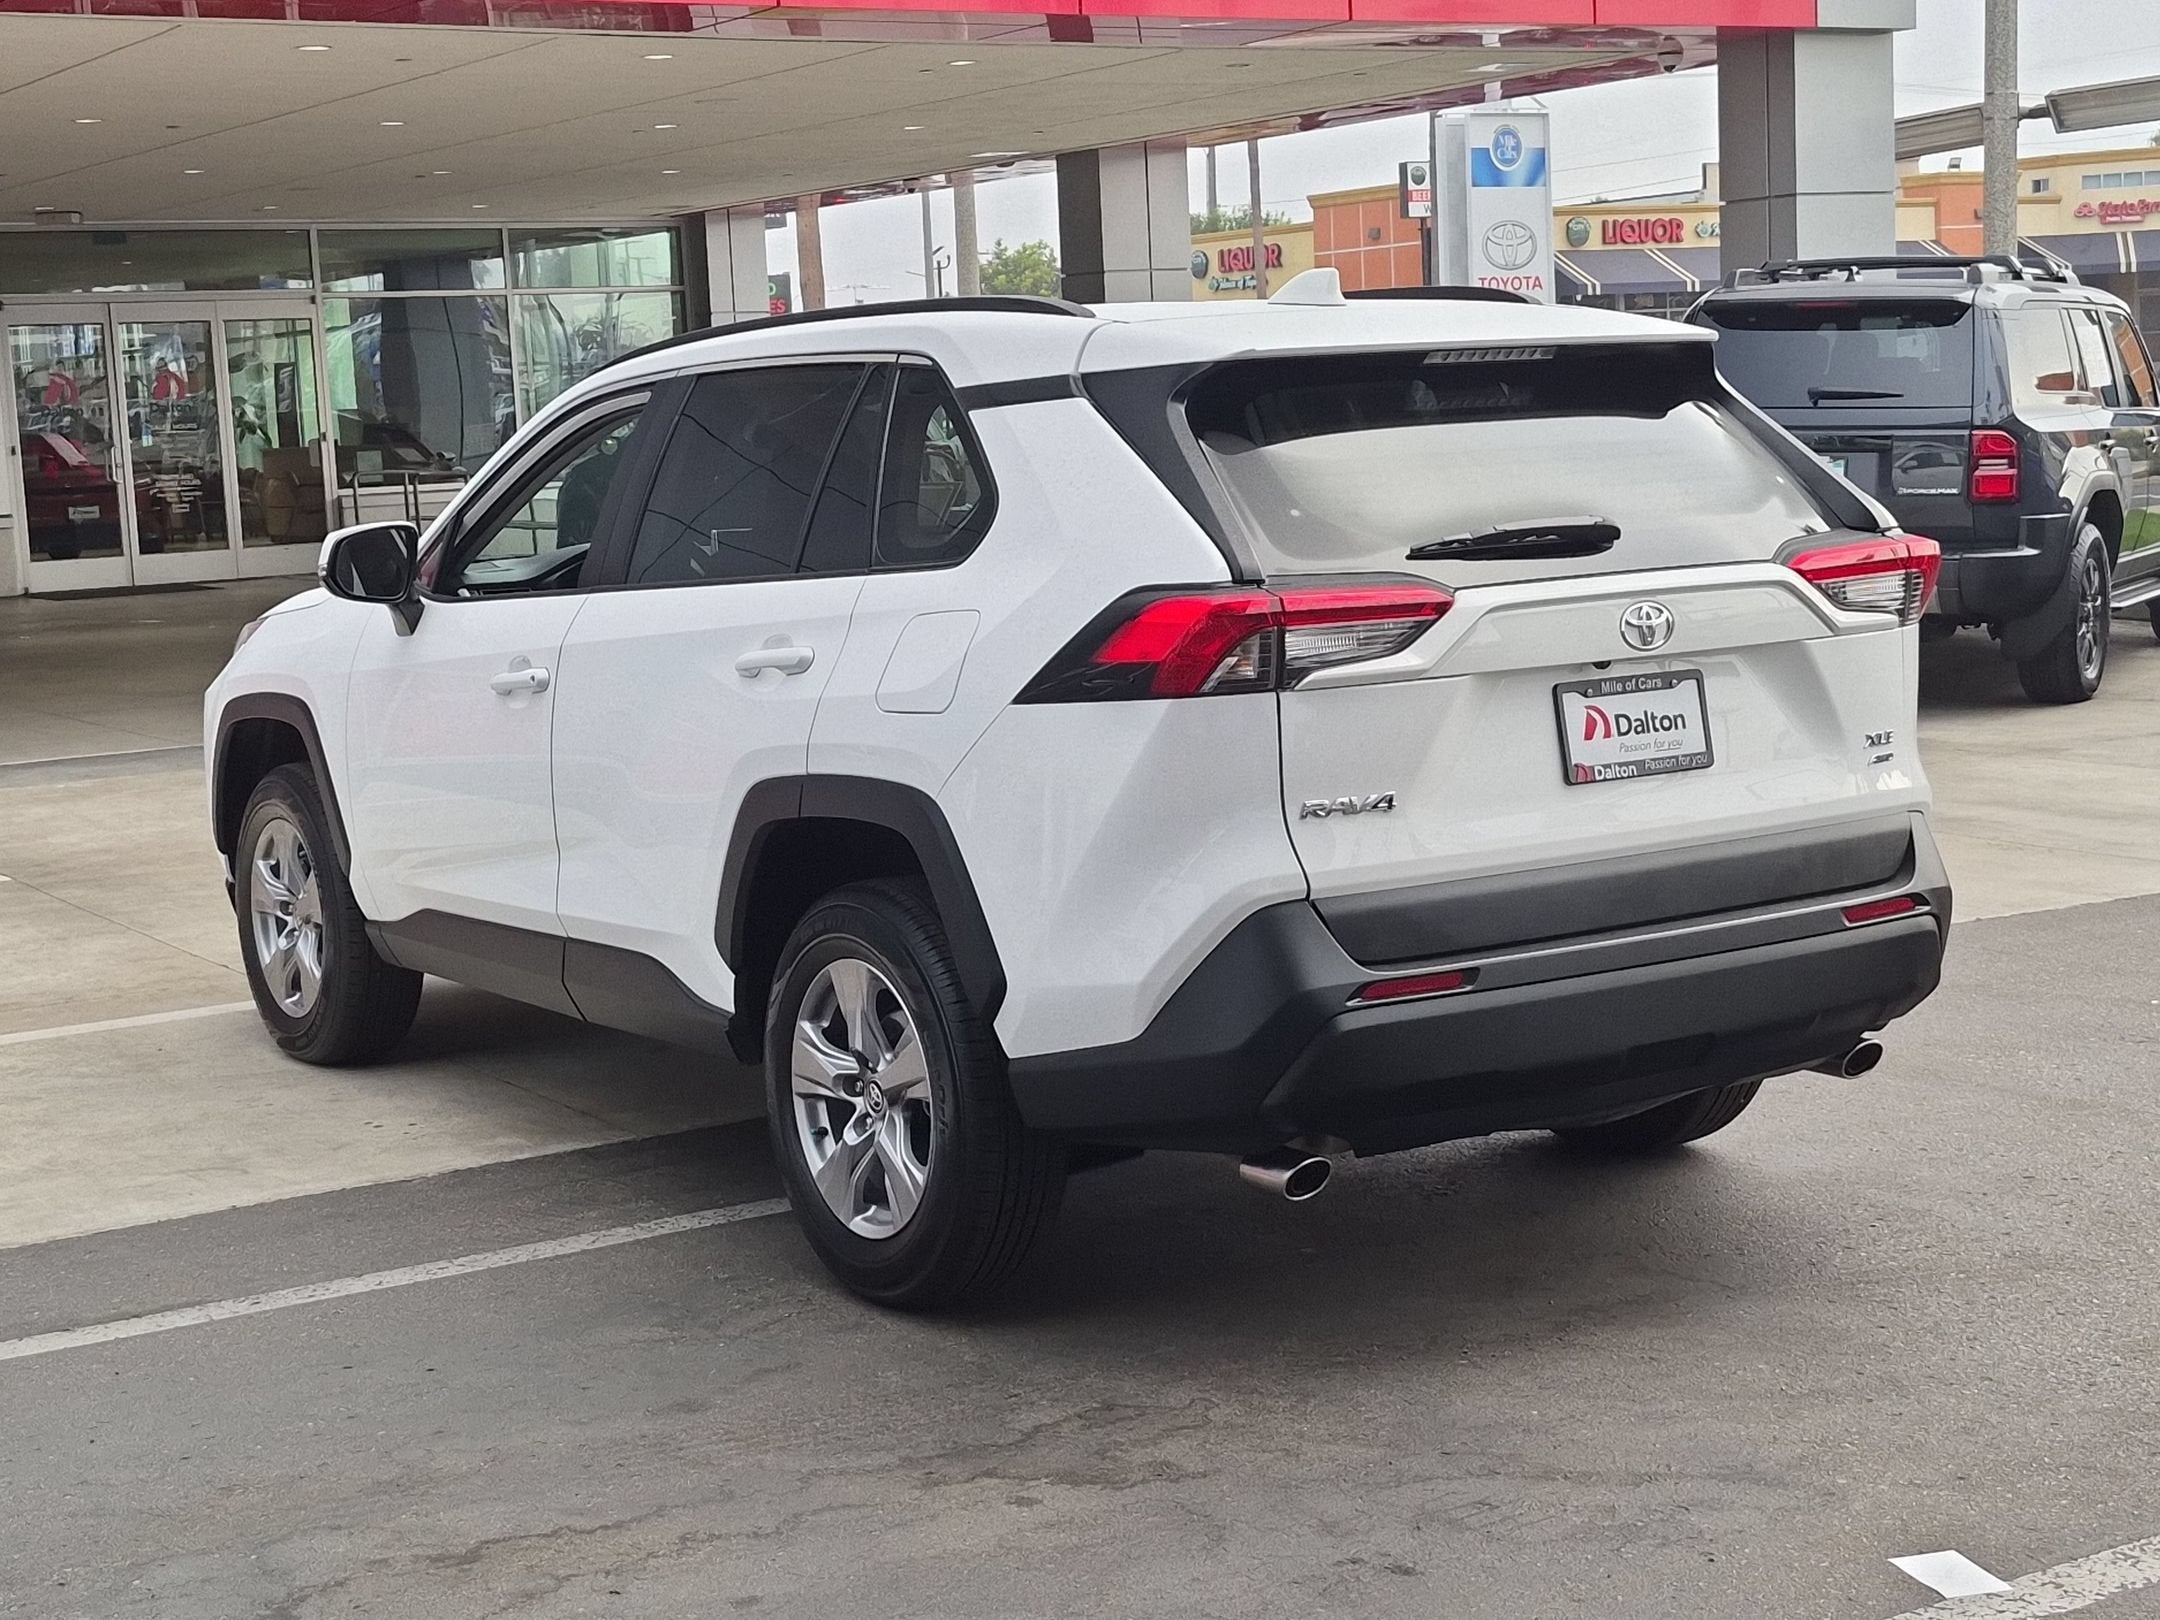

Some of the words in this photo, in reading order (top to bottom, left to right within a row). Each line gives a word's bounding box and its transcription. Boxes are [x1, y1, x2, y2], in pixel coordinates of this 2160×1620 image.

[1602, 218, 1684, 244] LIQUOR
[1478, 276, 1543, 291] TOYOTA
[1601, 680, 1623, 694] Mile
[1625, 680, 1636, 690] of
[1638, 678, 1662, 690] Cars
[1614, 710, 1687, 737] Dalton
[1619, 742, 1651, 753] Passion
[1653, 738, 1666, 750] for
[1667, 739, 1684, 750] you
[1863, 730, 1894, 749] XLE
[1594, 763, 1637, 781] Dalton
[1645, 756, 1676, 769] Passion
[1679, 754, 1690, 766] for
[1691, 754, 1708, 767] you
[1299, 791, 1397, 820] RAV4
